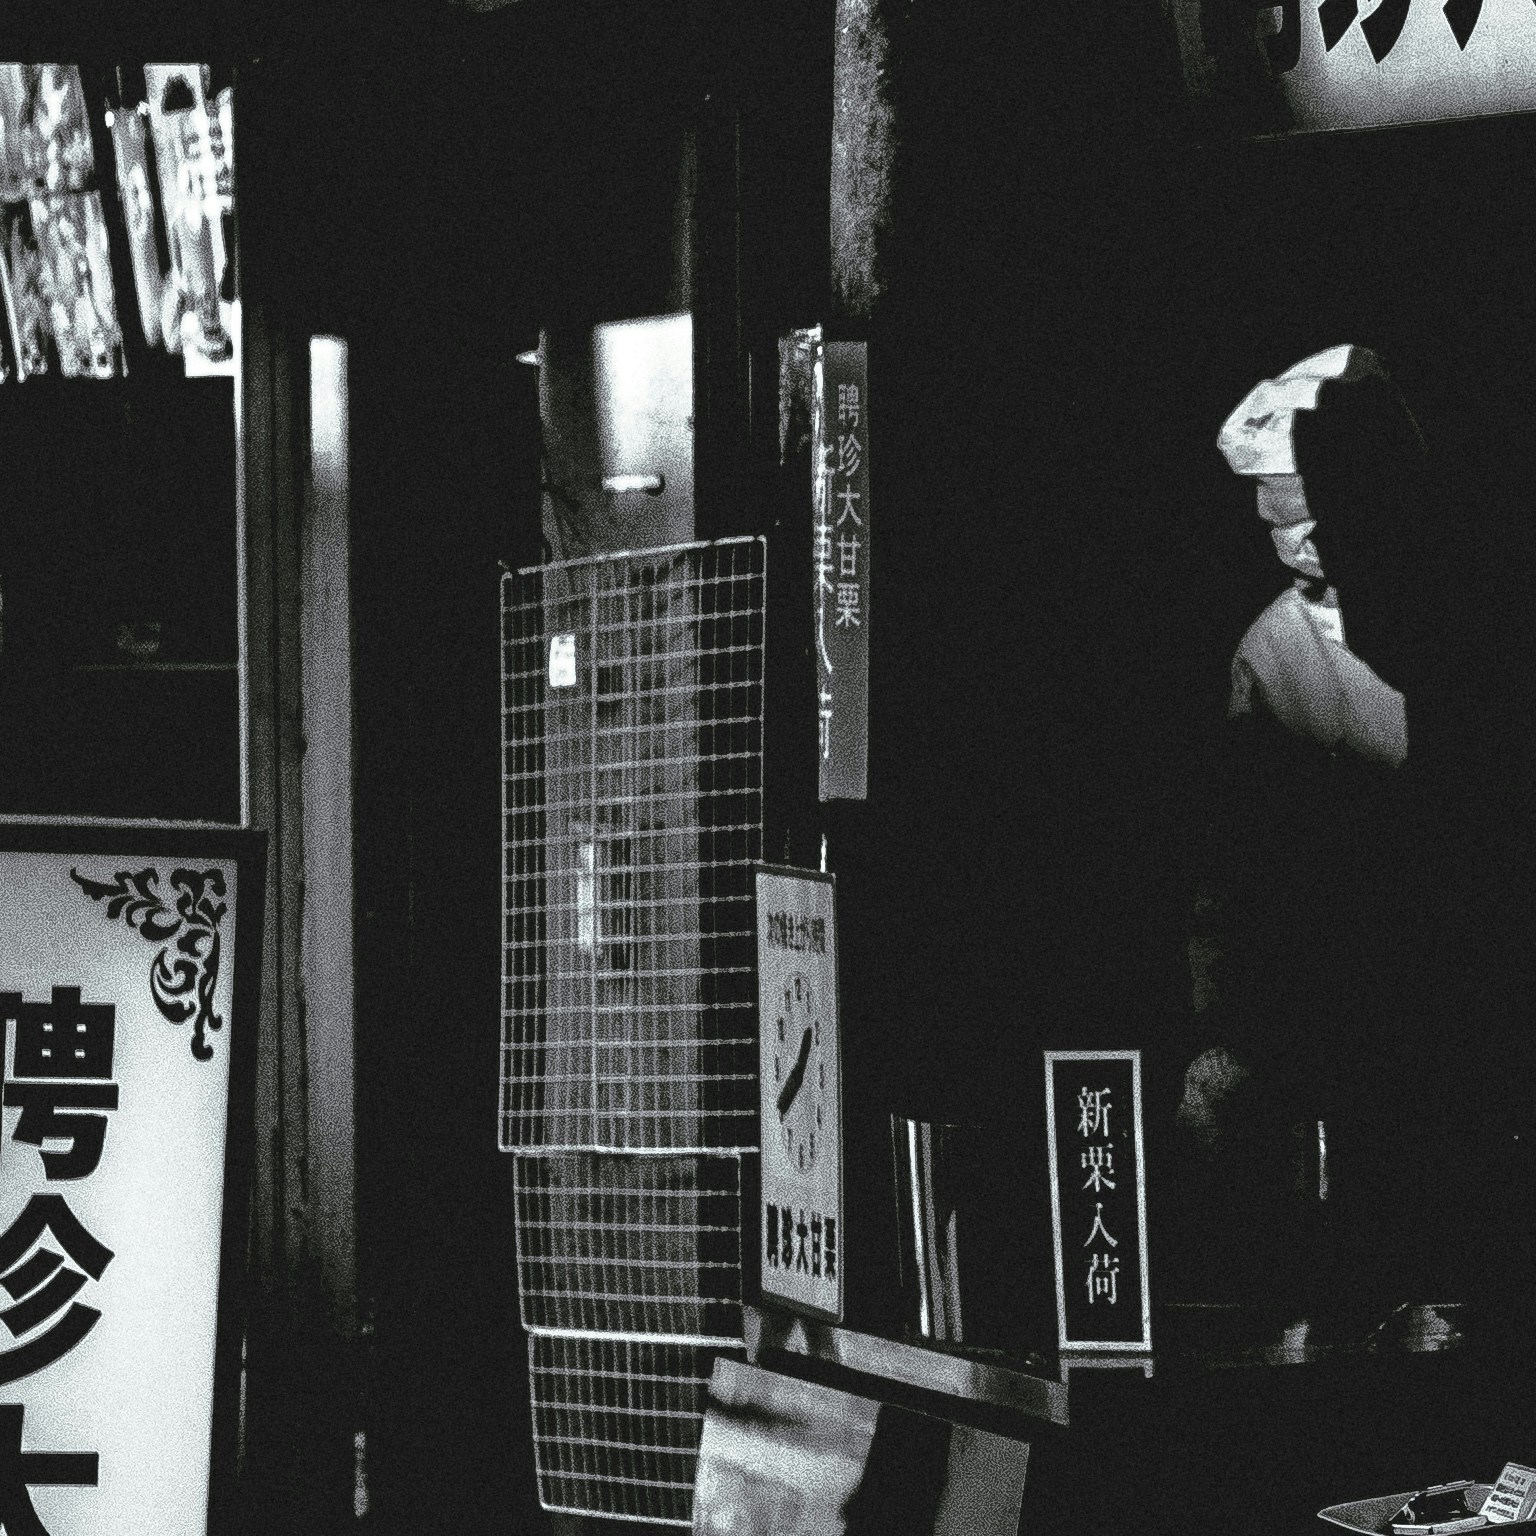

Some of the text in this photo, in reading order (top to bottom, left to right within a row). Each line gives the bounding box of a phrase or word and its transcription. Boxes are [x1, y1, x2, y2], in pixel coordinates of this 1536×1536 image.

[836, 383, 864, 628] 聘珍大甘栗
[1075, 1086, 1120, 1307] 新栗入荷
